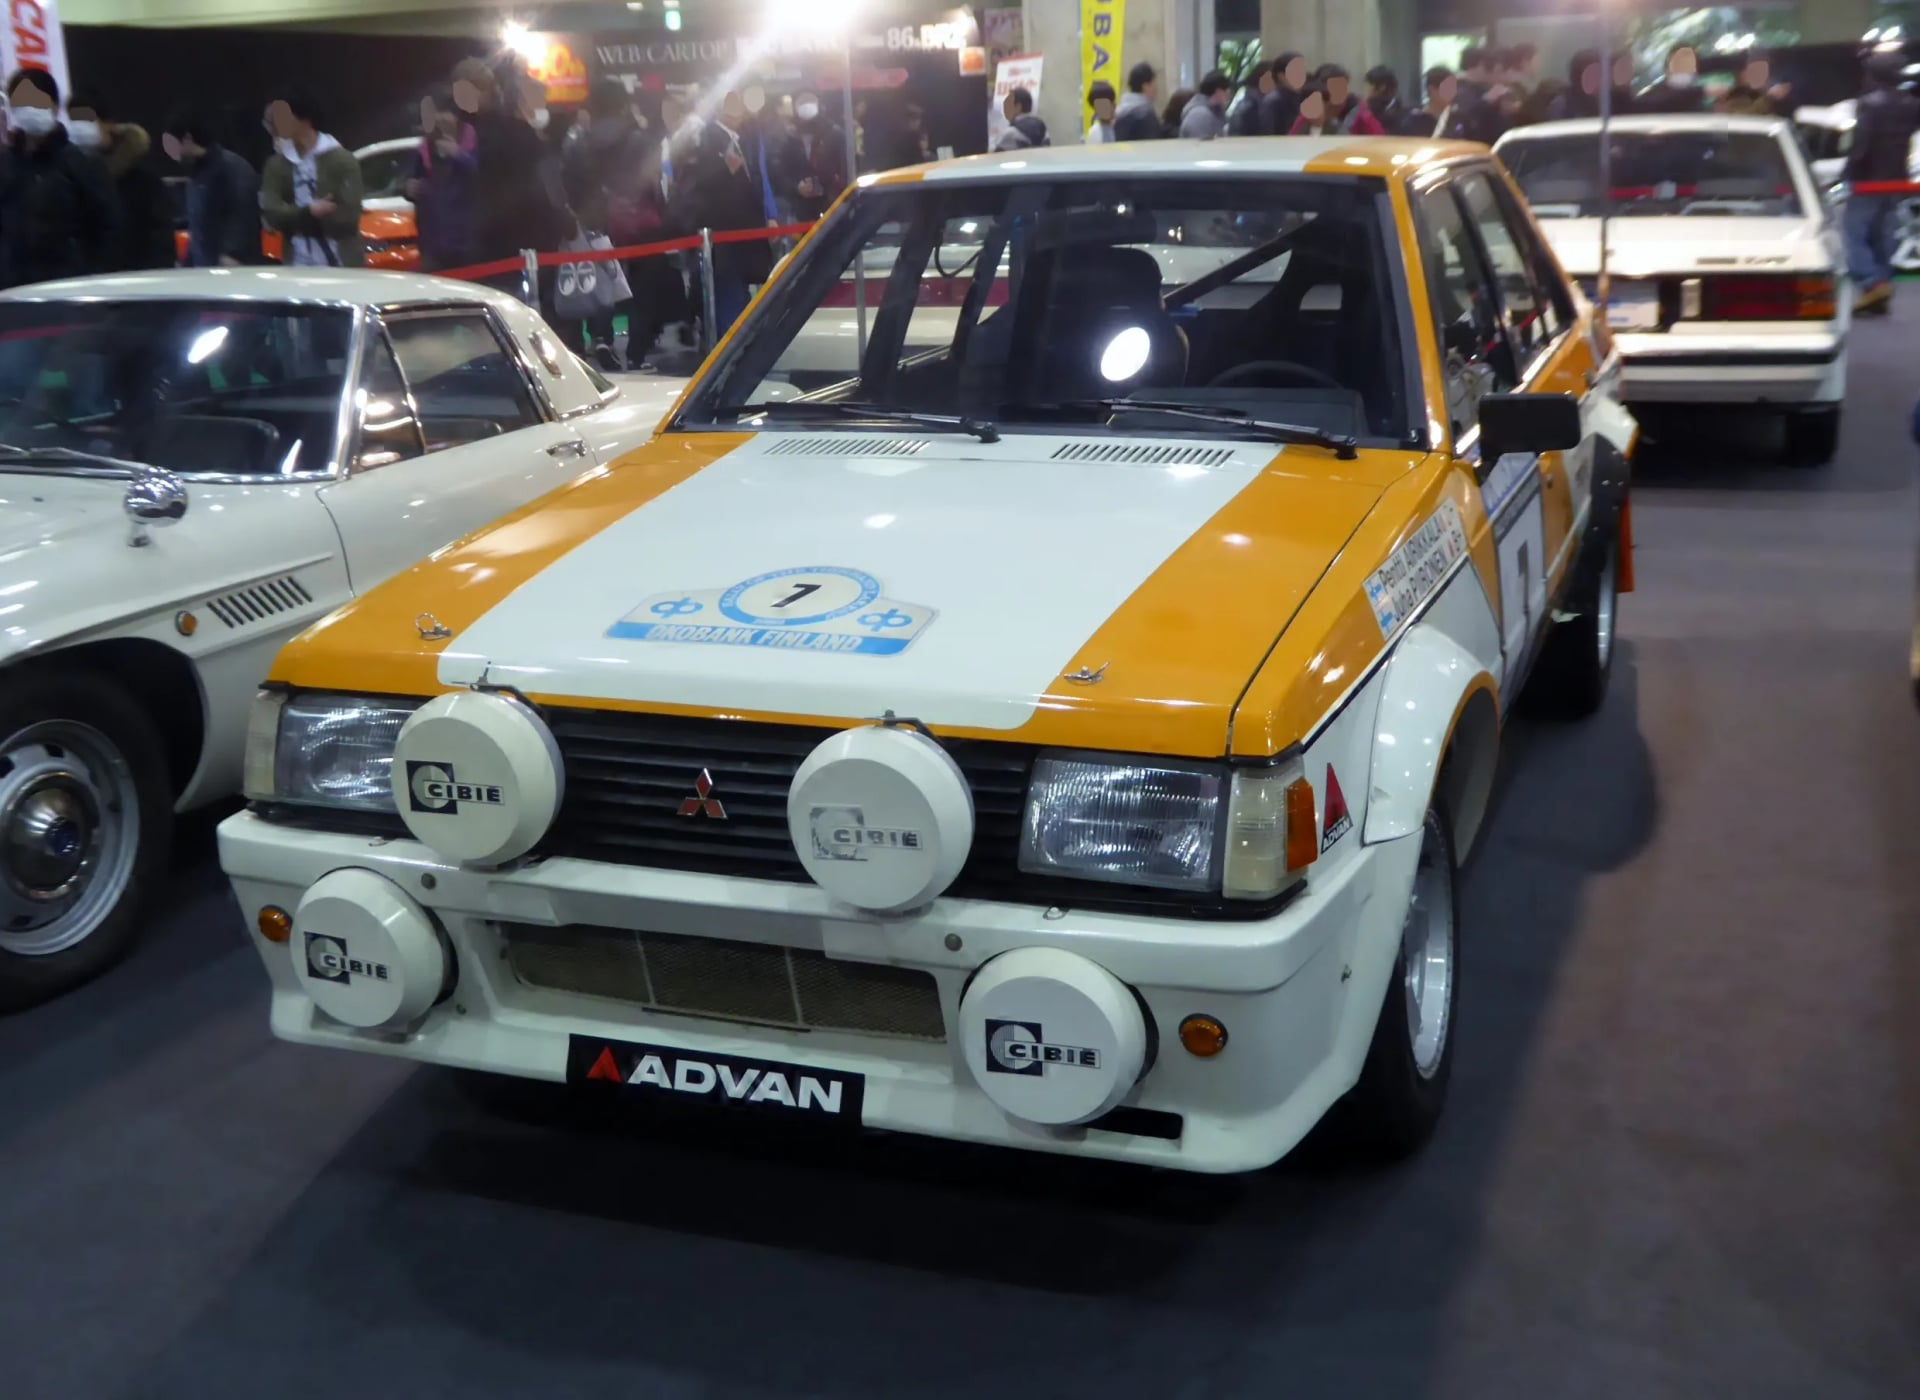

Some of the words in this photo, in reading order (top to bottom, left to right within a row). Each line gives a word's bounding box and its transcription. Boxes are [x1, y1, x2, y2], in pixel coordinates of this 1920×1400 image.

[596, 45, 641, 64] WEB
[757, 629, 863, 651] FINLAND
[1322, 815, 1351, 850] ADVAN
[627, 1054, 843, 1114] ADVAN
